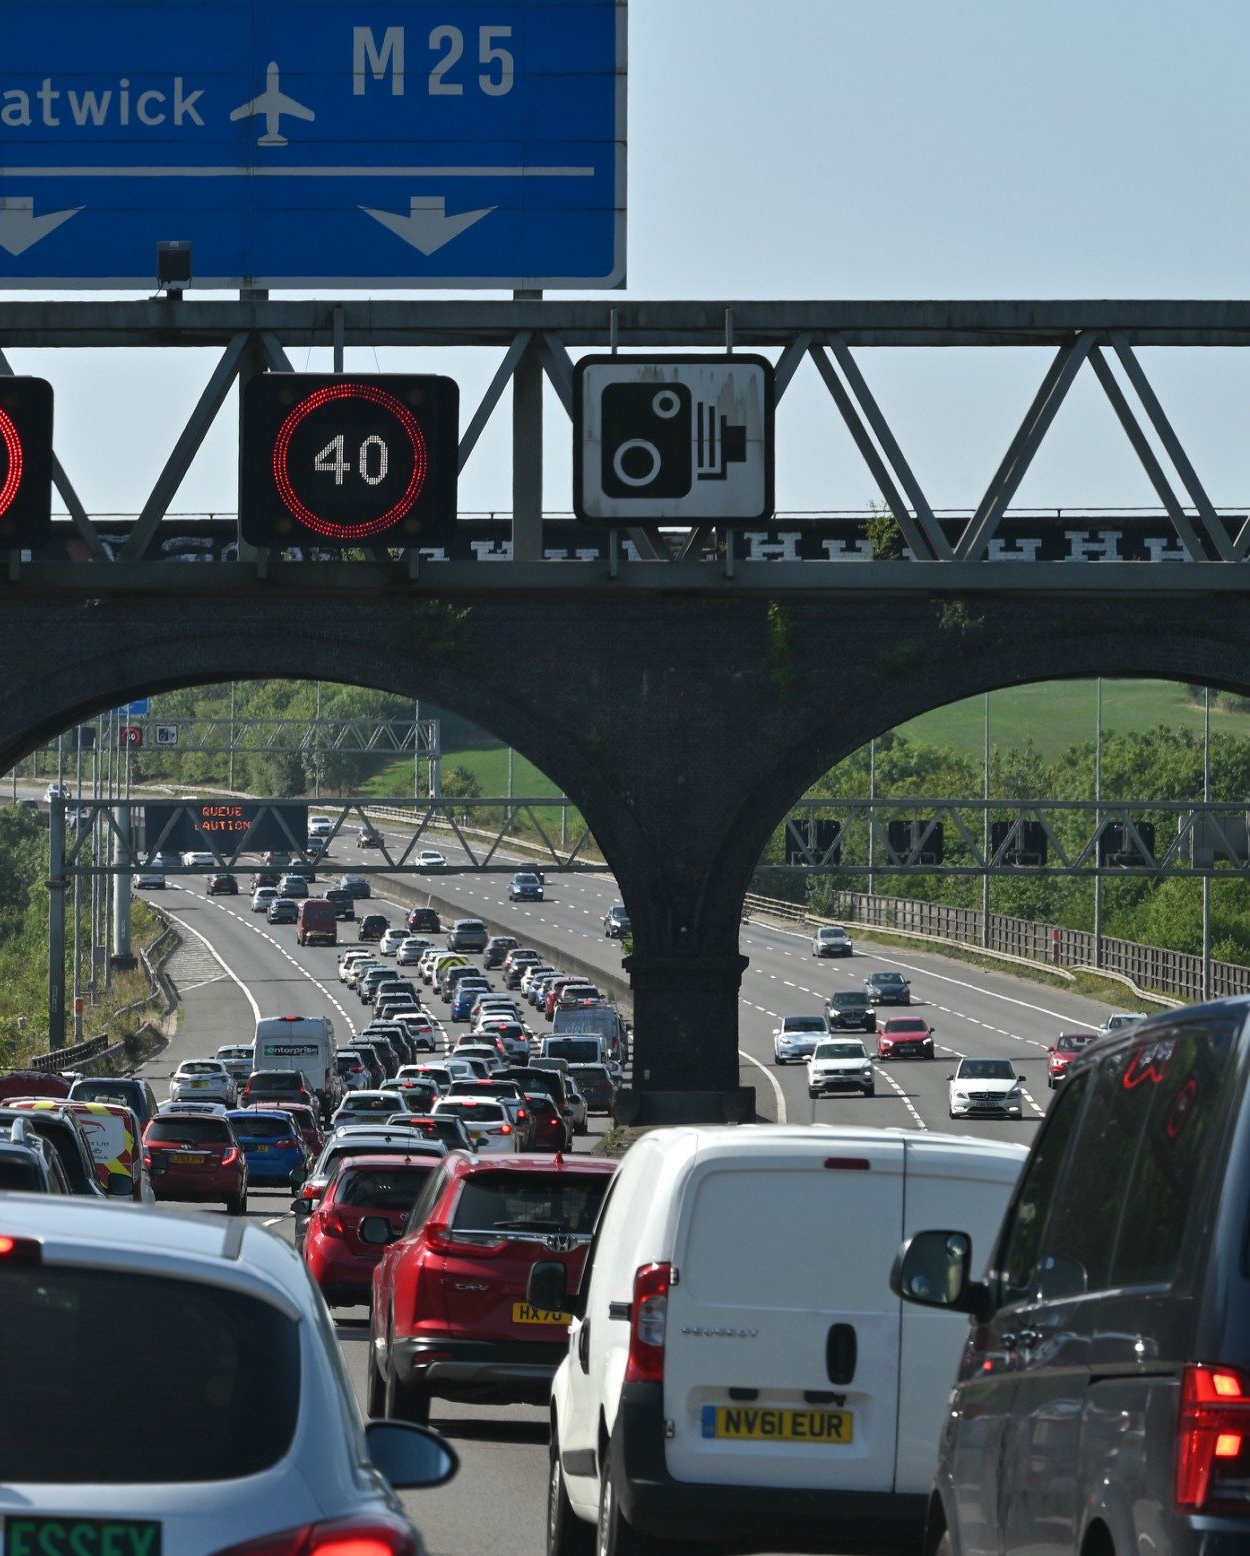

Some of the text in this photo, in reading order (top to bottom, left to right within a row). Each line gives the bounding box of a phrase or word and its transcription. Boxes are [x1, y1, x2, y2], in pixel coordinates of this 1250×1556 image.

[352, 25, 515, 96] M25
[313, 434, 389, 486] 40
[202, 806, 243, 817] QUEUE
[725, 1410, 843, 1438] NV61 EUR
